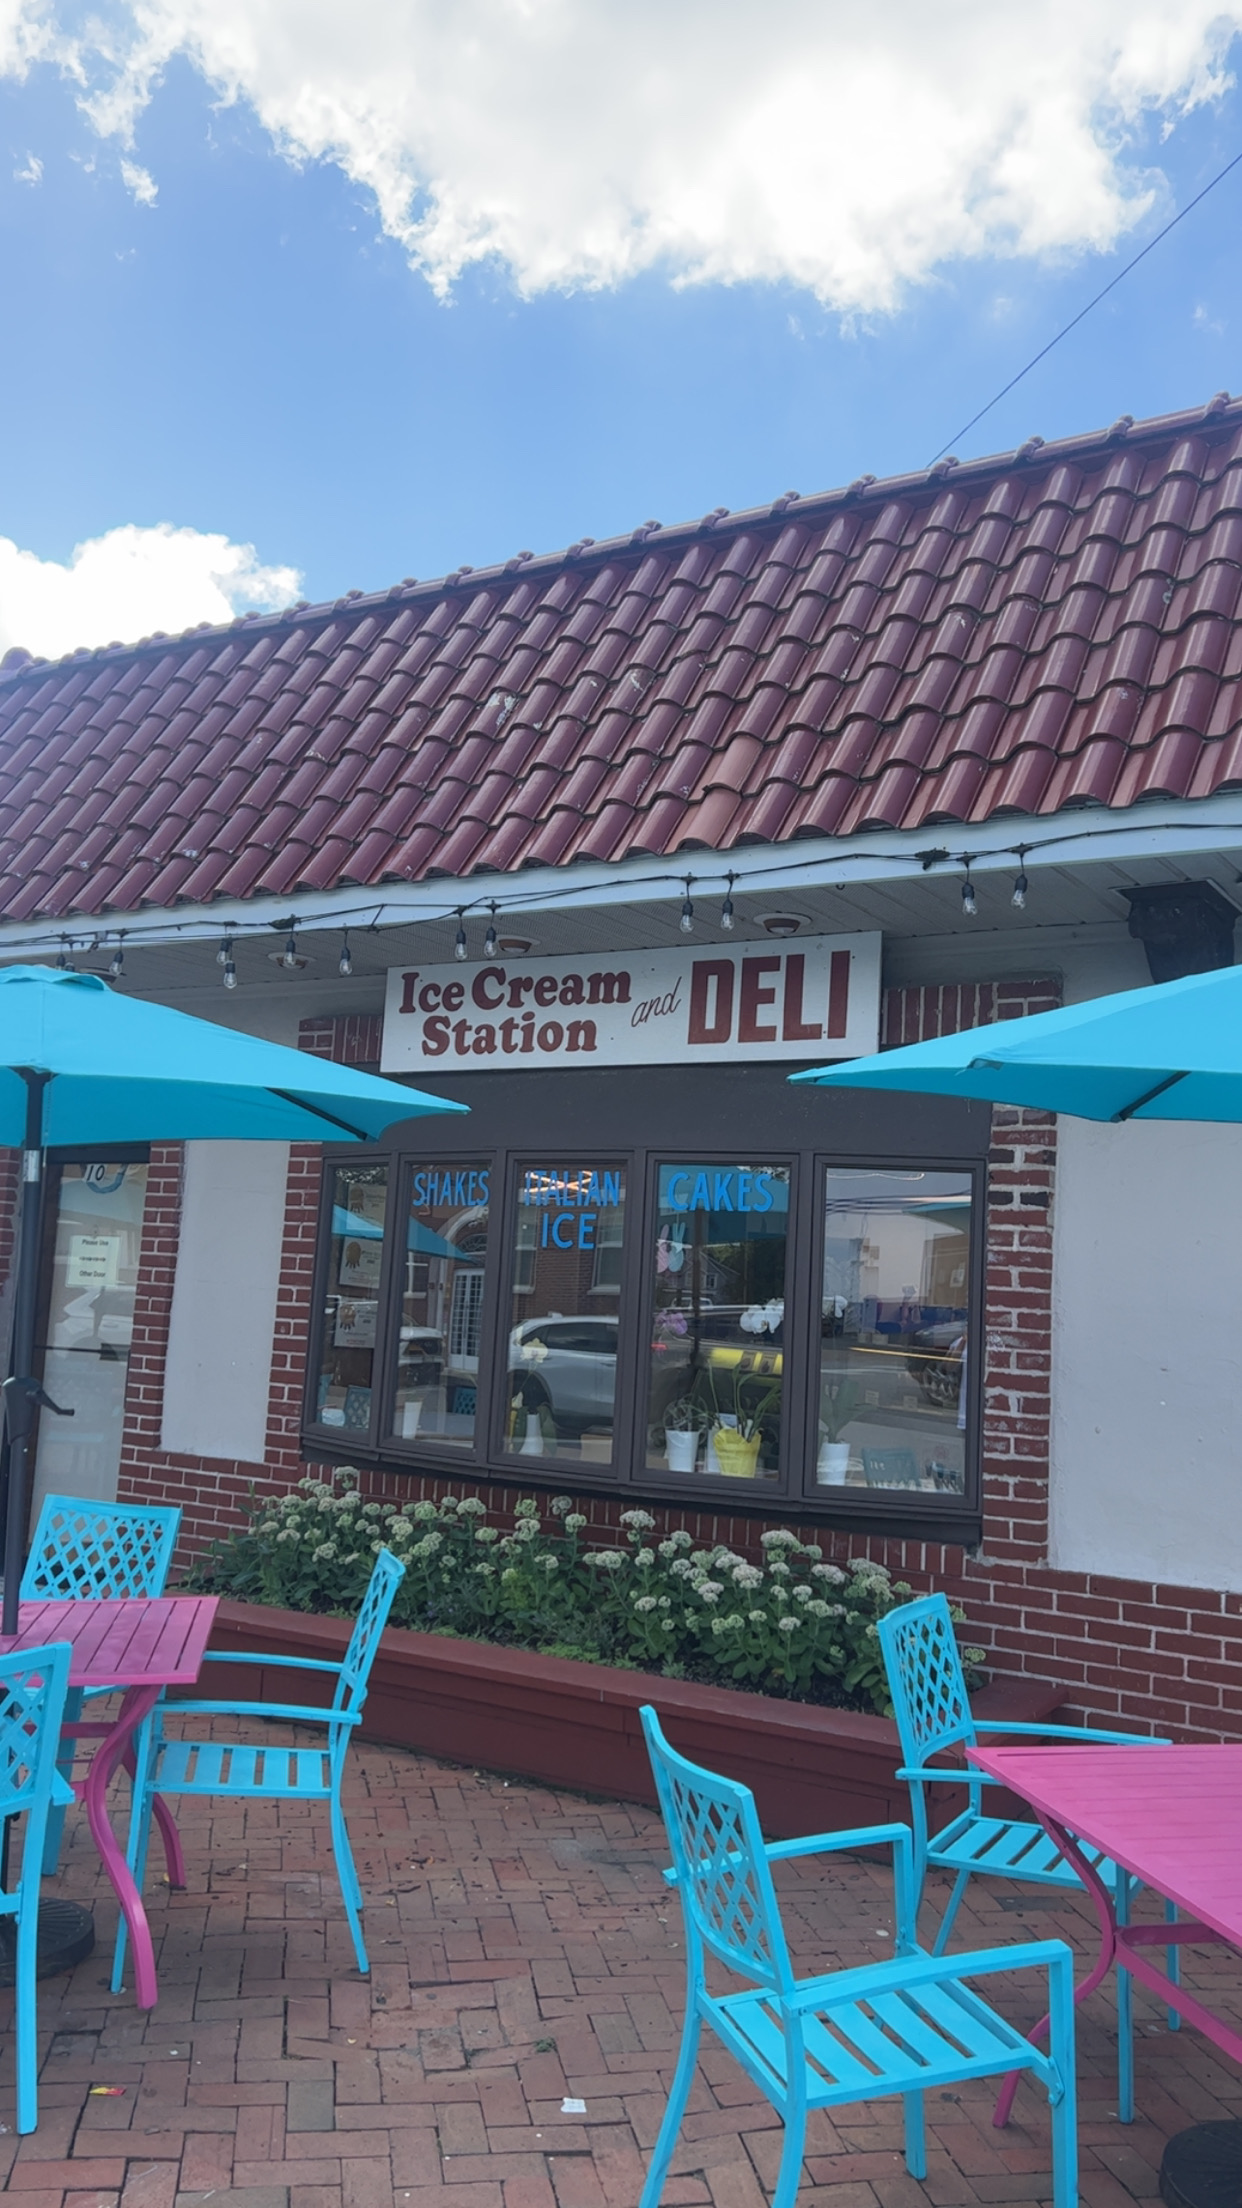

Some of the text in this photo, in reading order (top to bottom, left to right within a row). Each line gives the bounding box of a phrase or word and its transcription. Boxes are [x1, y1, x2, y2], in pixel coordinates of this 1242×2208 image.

[398, 966, 632, 1014] Ice Cream
[631, 976, 683, 1028] and
[688, 950, 851, 1045] DELI
[421, 1012, 598, 1057] Station
[86, 1164, 105, 1181] 10
[412, 1170, 490, 1207] SHAKES
[524, 1170, 620, 1208] ITALIAN
[667, 1172, 775, 1212] CAKES
[541, 1212, 598, 1250] ICE
